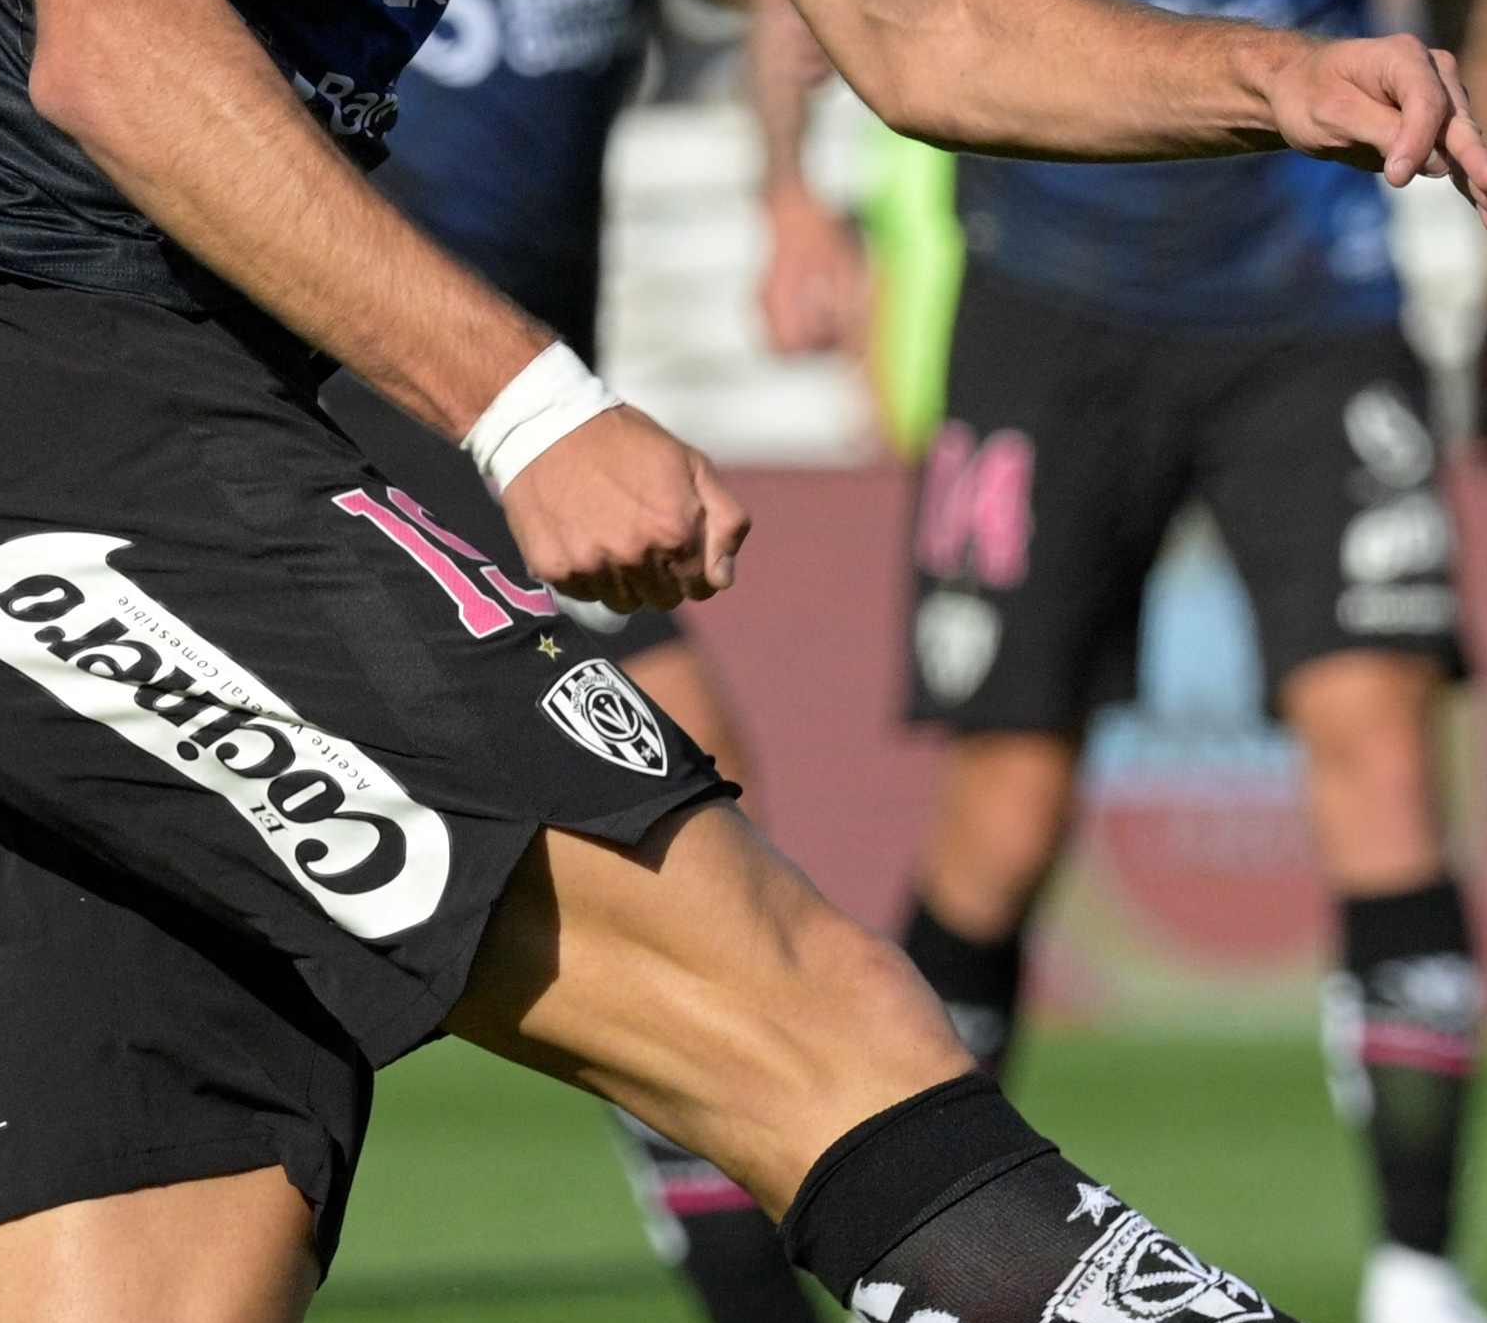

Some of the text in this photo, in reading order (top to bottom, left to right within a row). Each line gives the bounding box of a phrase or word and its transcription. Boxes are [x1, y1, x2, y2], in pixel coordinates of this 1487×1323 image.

[117, 595, 219, 681] Comestible
[311, 734, 371, 793] Aceite
[249, 802, 289, 835] El
